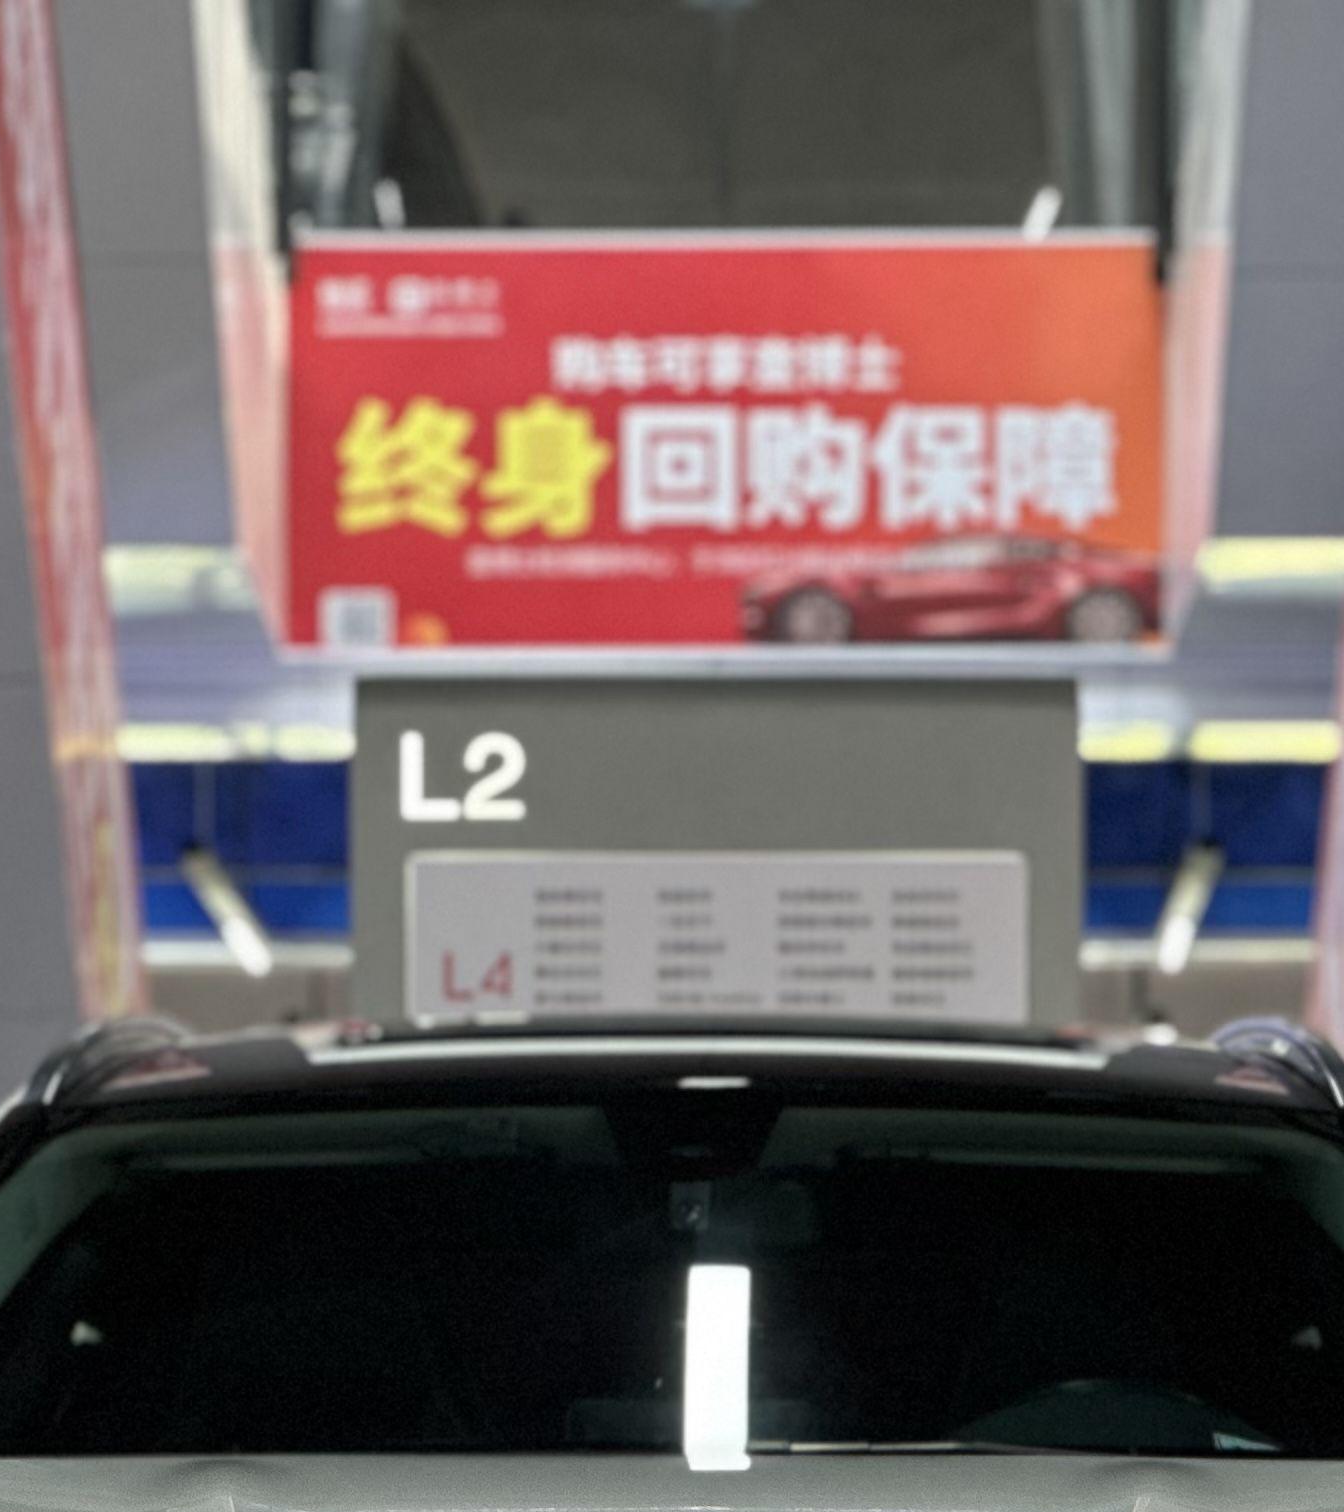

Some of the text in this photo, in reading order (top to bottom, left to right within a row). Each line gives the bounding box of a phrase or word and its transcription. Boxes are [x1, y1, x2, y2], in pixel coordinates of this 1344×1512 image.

[336, 397, 1116, 536] 终身回购保障
[400, 730, 526, 821] L2
[441, 950, 515, 1003] L4
